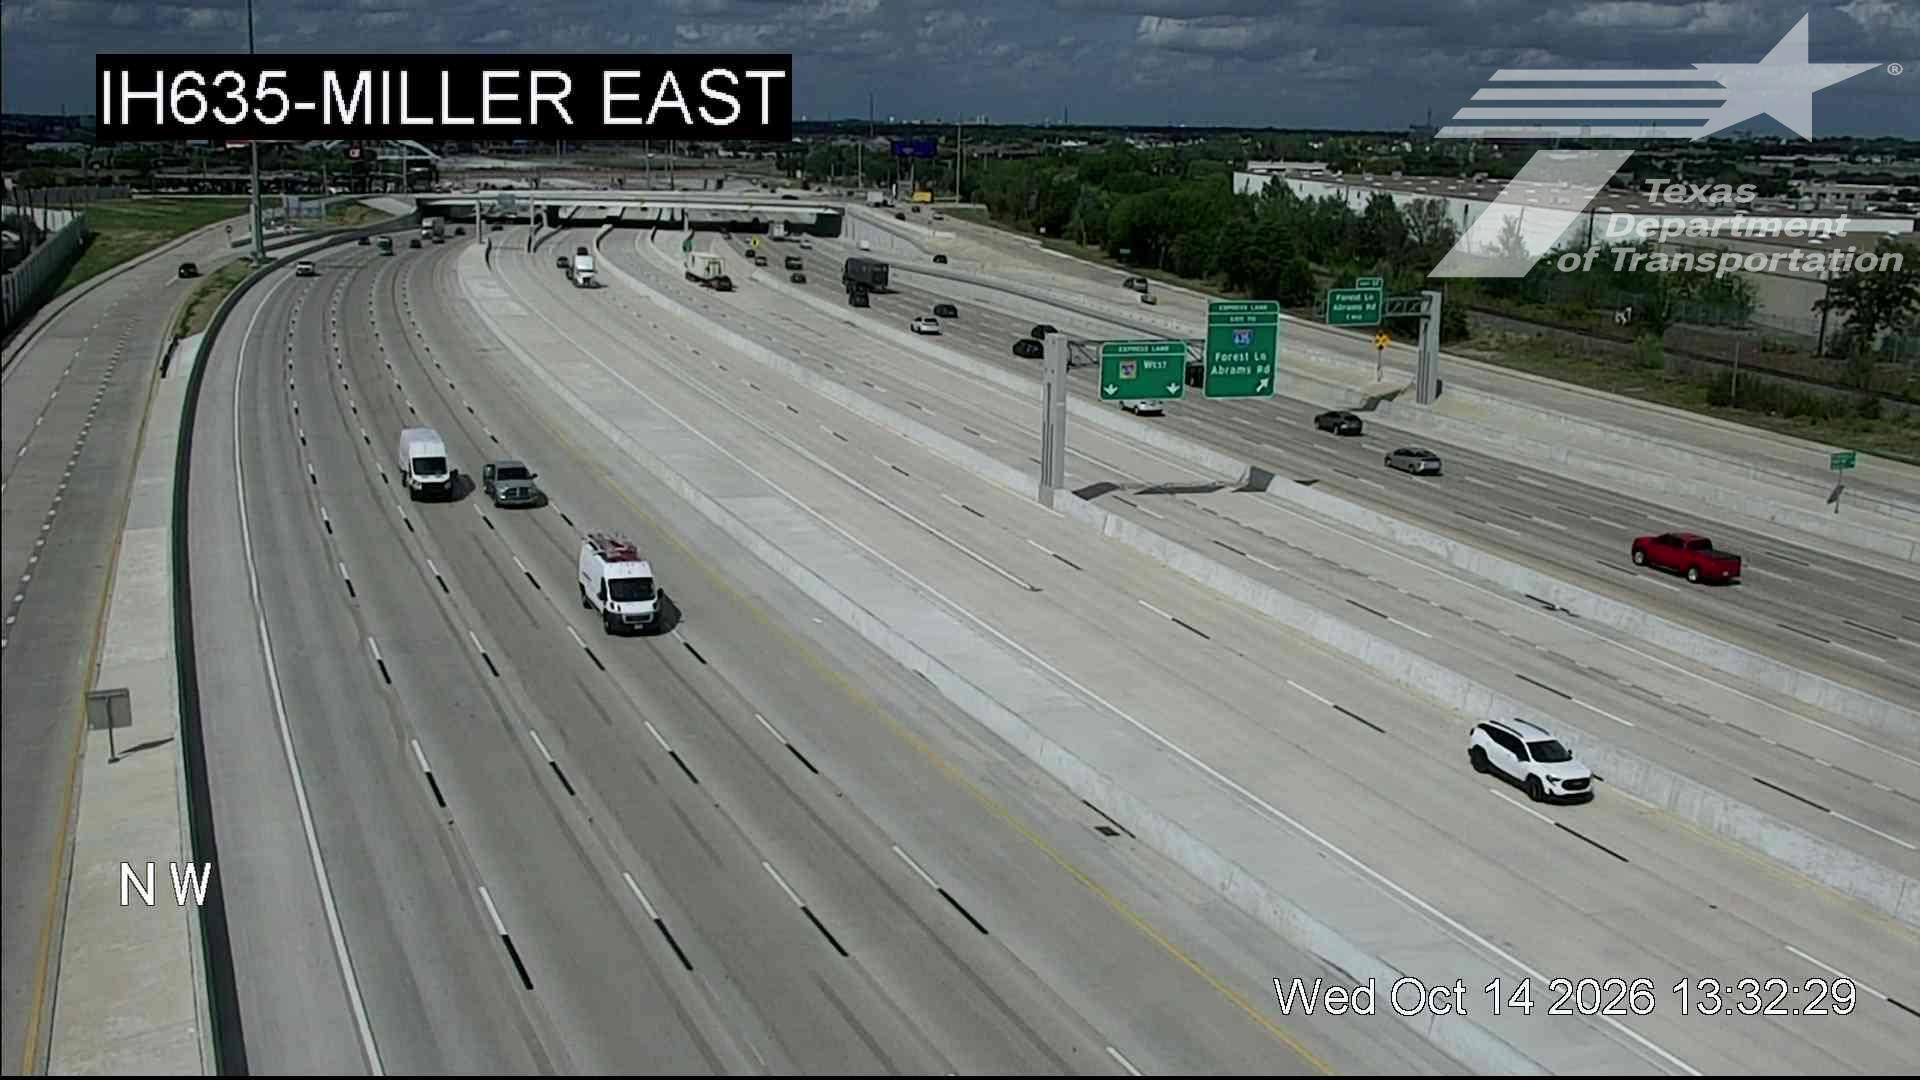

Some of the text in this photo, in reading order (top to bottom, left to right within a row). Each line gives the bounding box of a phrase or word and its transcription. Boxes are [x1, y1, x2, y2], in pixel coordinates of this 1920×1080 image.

[1215, 352, 1267, 362] Forest Ln
[1210, 364, 1271, 375] Abrams Rd
